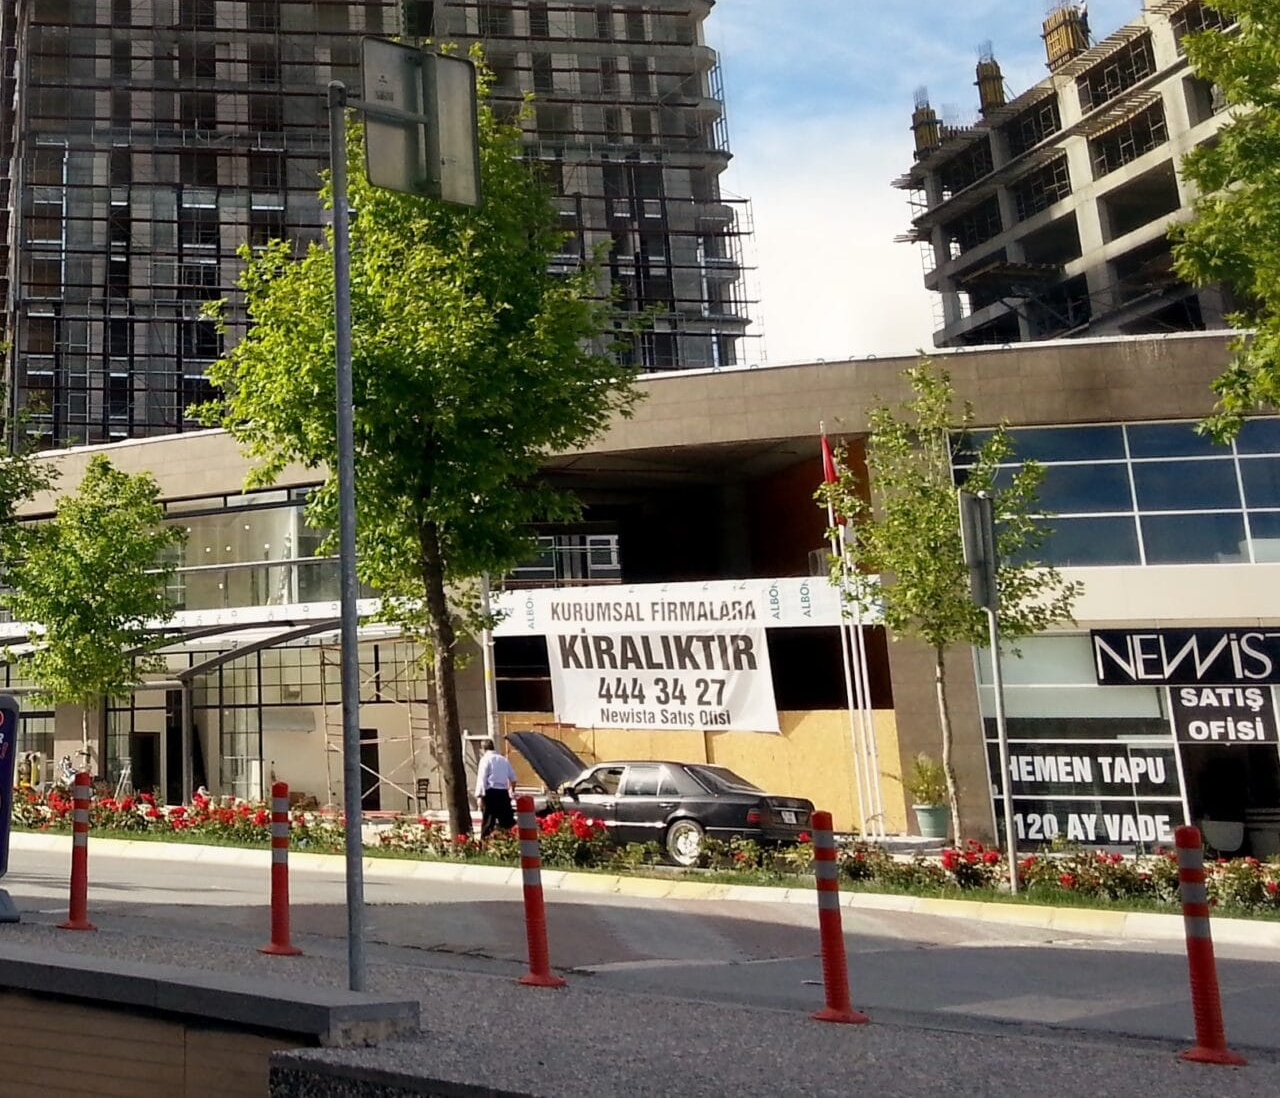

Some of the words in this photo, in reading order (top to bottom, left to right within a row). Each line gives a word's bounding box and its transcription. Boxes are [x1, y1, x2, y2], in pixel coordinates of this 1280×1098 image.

[550, 601, 644, 622] KURUMSAL
[650, 598, 757, 622] FİRMALARA
[558, 627, 758, 671] KİRALIKTIR
[597, 676, 646, 705] 444
[654, 677, 687, 706] 34
[695, 678, 726, 707] 27
[1180, 687, 1265, 712] SATIŞ
[600, 708, 656, 724] Newista
[660, 709, 695, 727] Satış
[1188, 716, 1265, 741] OFİSİ
[1097, 756, 1166, 784] TAPU
[1013, 813, 1060, 840] 120
[1066, 813, 1097, 841] AY
[1102, 814, 1175, 842] VADE
